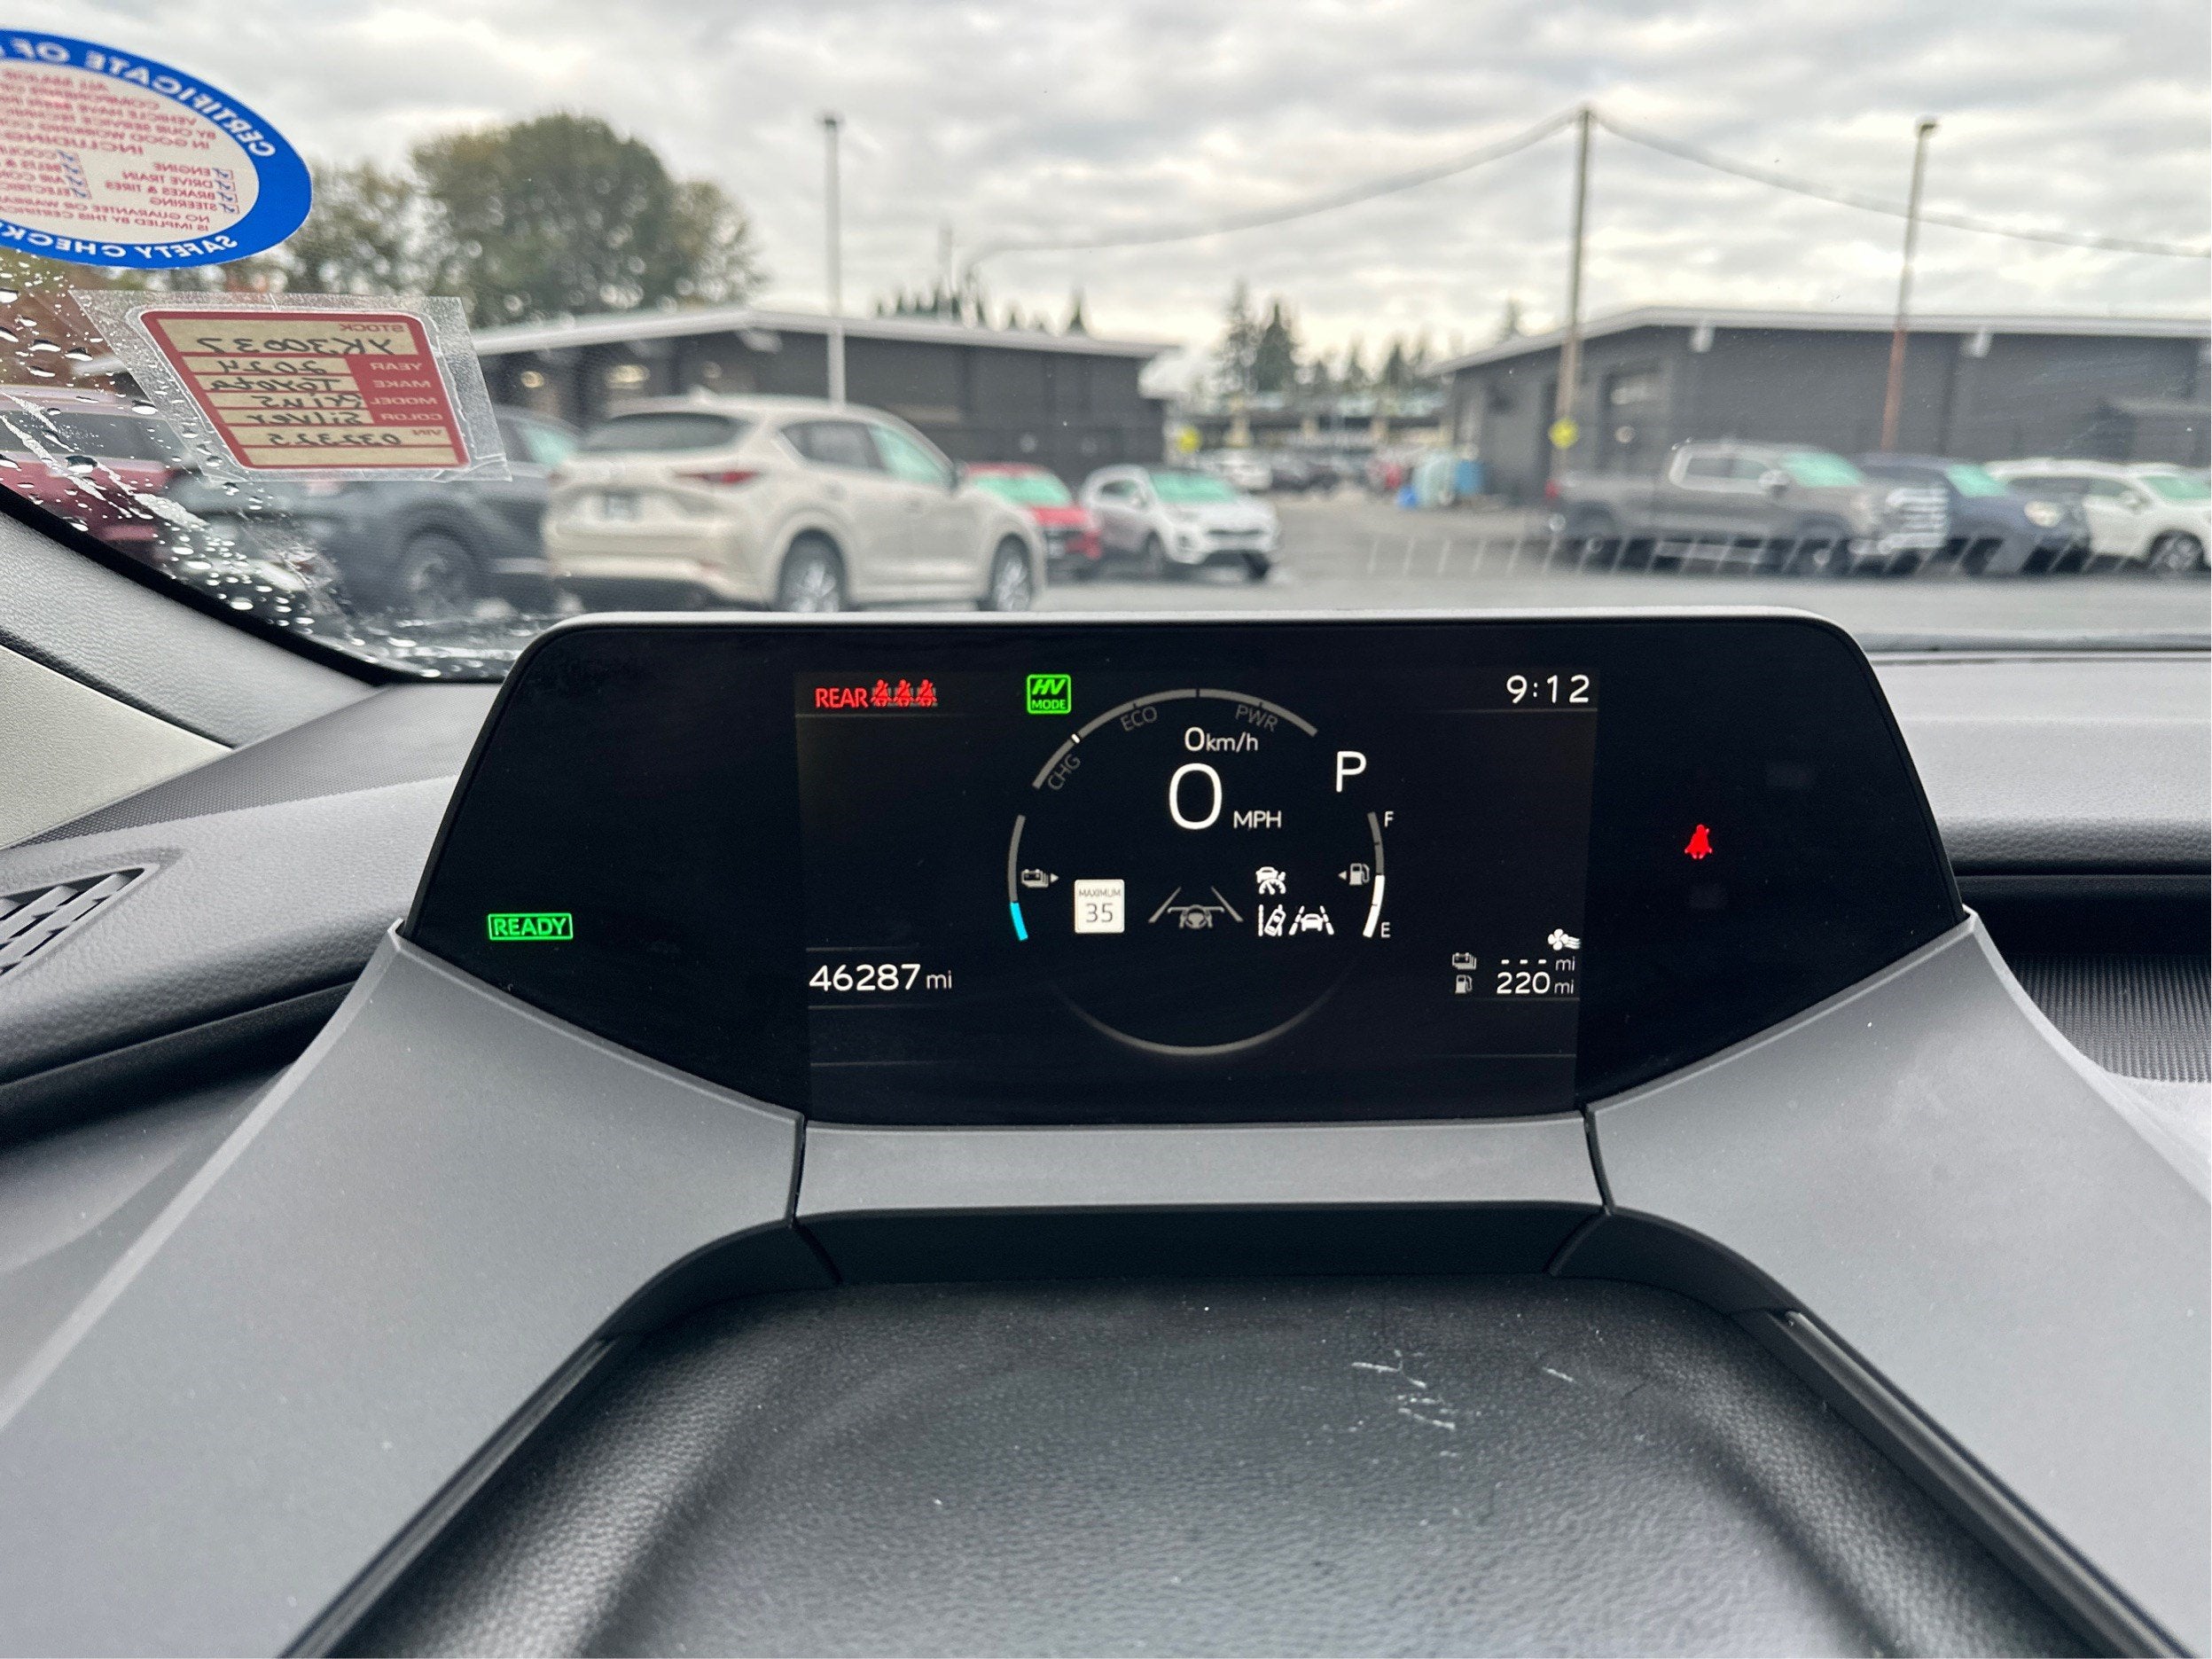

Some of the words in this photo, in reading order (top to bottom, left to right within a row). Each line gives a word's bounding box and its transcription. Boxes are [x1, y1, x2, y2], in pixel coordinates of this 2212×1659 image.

[1031, 678, 1067, 695] HV
[1506, 675, 1590, 703] 9:12
[815, 687, 869, 708] REAR
[1031, 699, 1067, 709] MODE
[1121, 706, 1158, 732] ECO
[1235, 704, 1278, 732] PWR
[1047, 753, 1081, 790] CHG
[1335, 751, 1366, 792] P
[1169, 763, 1222, 829] 0
[1233, 810, 1281, 828] MPH
[1384, 811, 1394, 827] F
[1078, 888, 1122, 898] MAXIMUM
[1085, 903, 1114, 923] 35
[494, 918, 567, 936] READY
[1381, 922, 1390, 938] E
[1555, 957, 1575, 970] mi
[809, 963, 920, 990] 46287
[926, 969, 952, 990] mi
[1497, 971, 1551, 995] 220
[1554, 980, 1575, 995] mi
